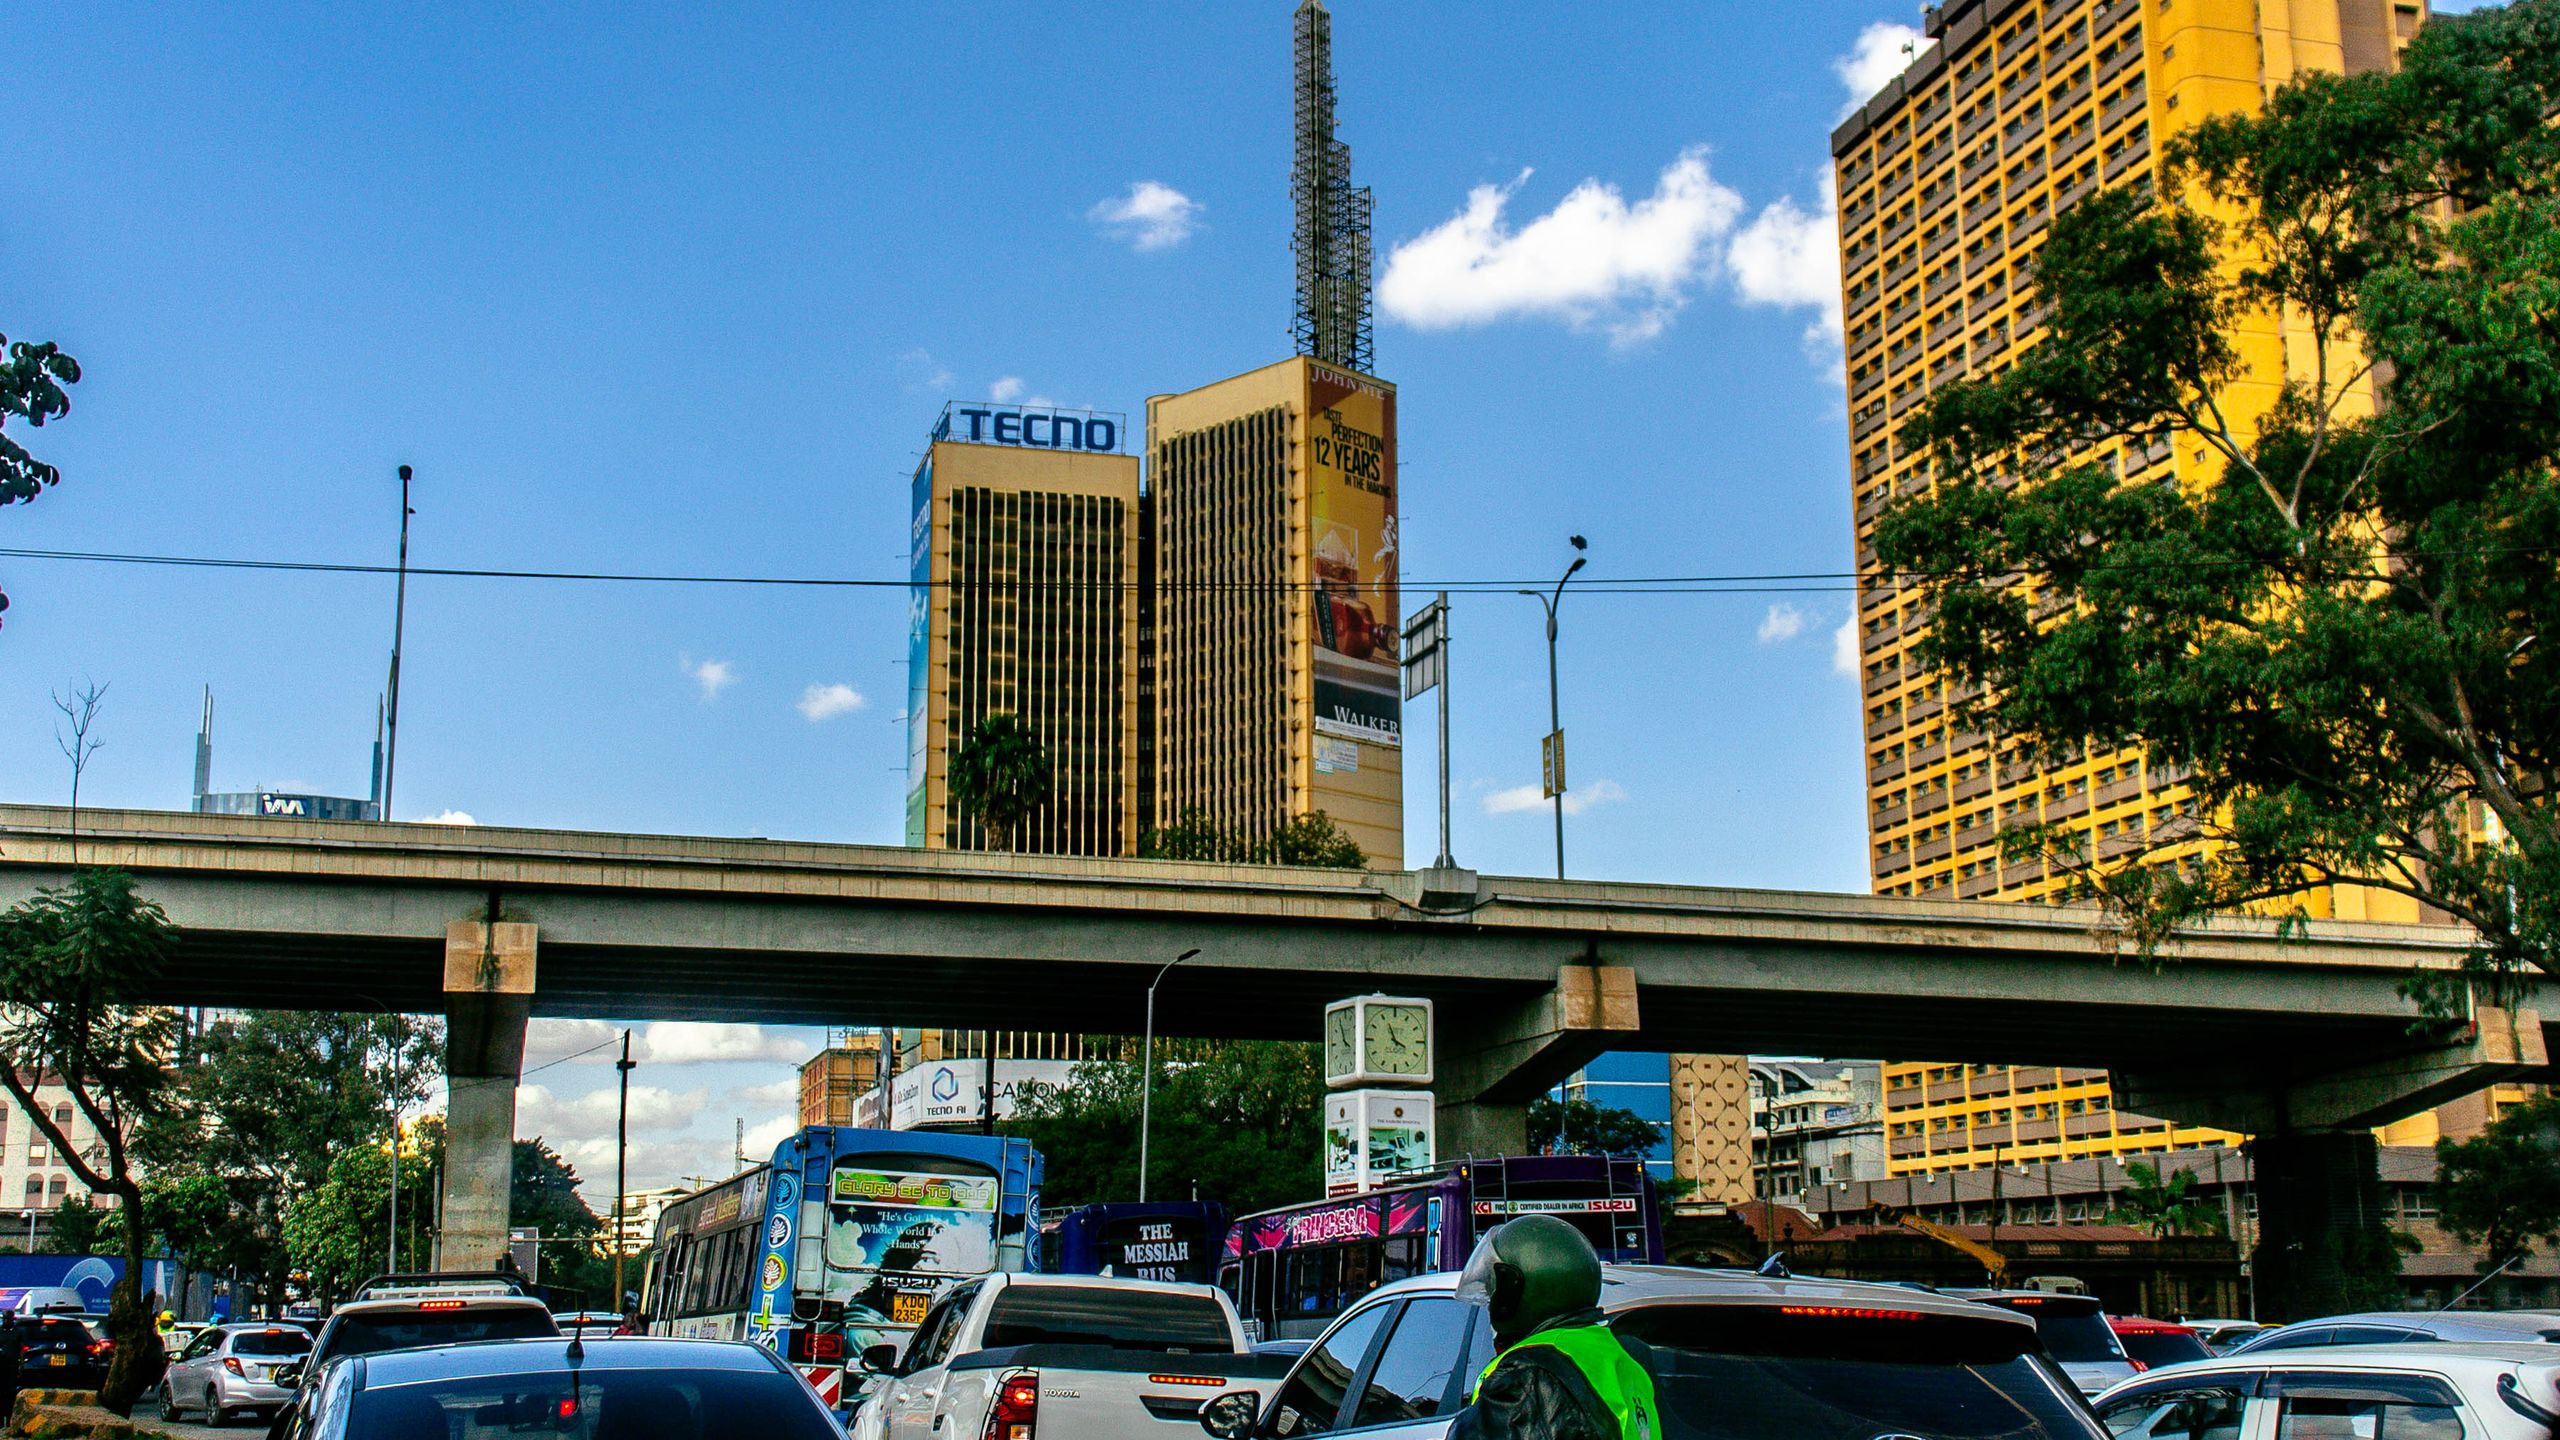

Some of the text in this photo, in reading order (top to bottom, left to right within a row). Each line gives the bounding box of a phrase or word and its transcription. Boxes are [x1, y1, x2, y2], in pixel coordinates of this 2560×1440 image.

[1311, 366, 1385, 400] JOHNNIE
[1322, 406, 1343, 423] TASTE
[960, 408, 1116, 451] TECNO
[1331, 422, 1384, 454] PERFECTION
[1314, 436, 1380, 482] 12 YEARS
[1344, 474, 1352, 487] IN
[1352, 476, 1365, 491] THE
[1334, 704, 1399, 735] WALKER
[926, 1107, 953, 1116] TECNO
[839, 1179, 897, 1198] GLORY
[898, 1182, 924, 1199] BE
[926, 1184, 952, 1200] TO
[1473, 1200, 1492, 1214] KCI
[1519, 1203, 1543, 1211] CERTIFIED
[1568, 1202, 1585, 1210] AFRICA
[1588, 1200, 1633, 1211] ISUZU
[877, 1211, 900, 1222] "He's
[903, 1213, 921, 1223] Got
[863, 1223, 893, 1235] Whole
[895, 1225, 925, 1237] World
[1139, 1223, 1174, 1240] THE
[1124, 1241, 1189, 1264] MESSIAH
[882, 1276, 936, 1289] ISUZU
[1136, 1266, 1177, 1282] BUS
[901, 1295, 926, 1309] KDQ
[1044, 1389, 1081, 1399] TOYOTA
